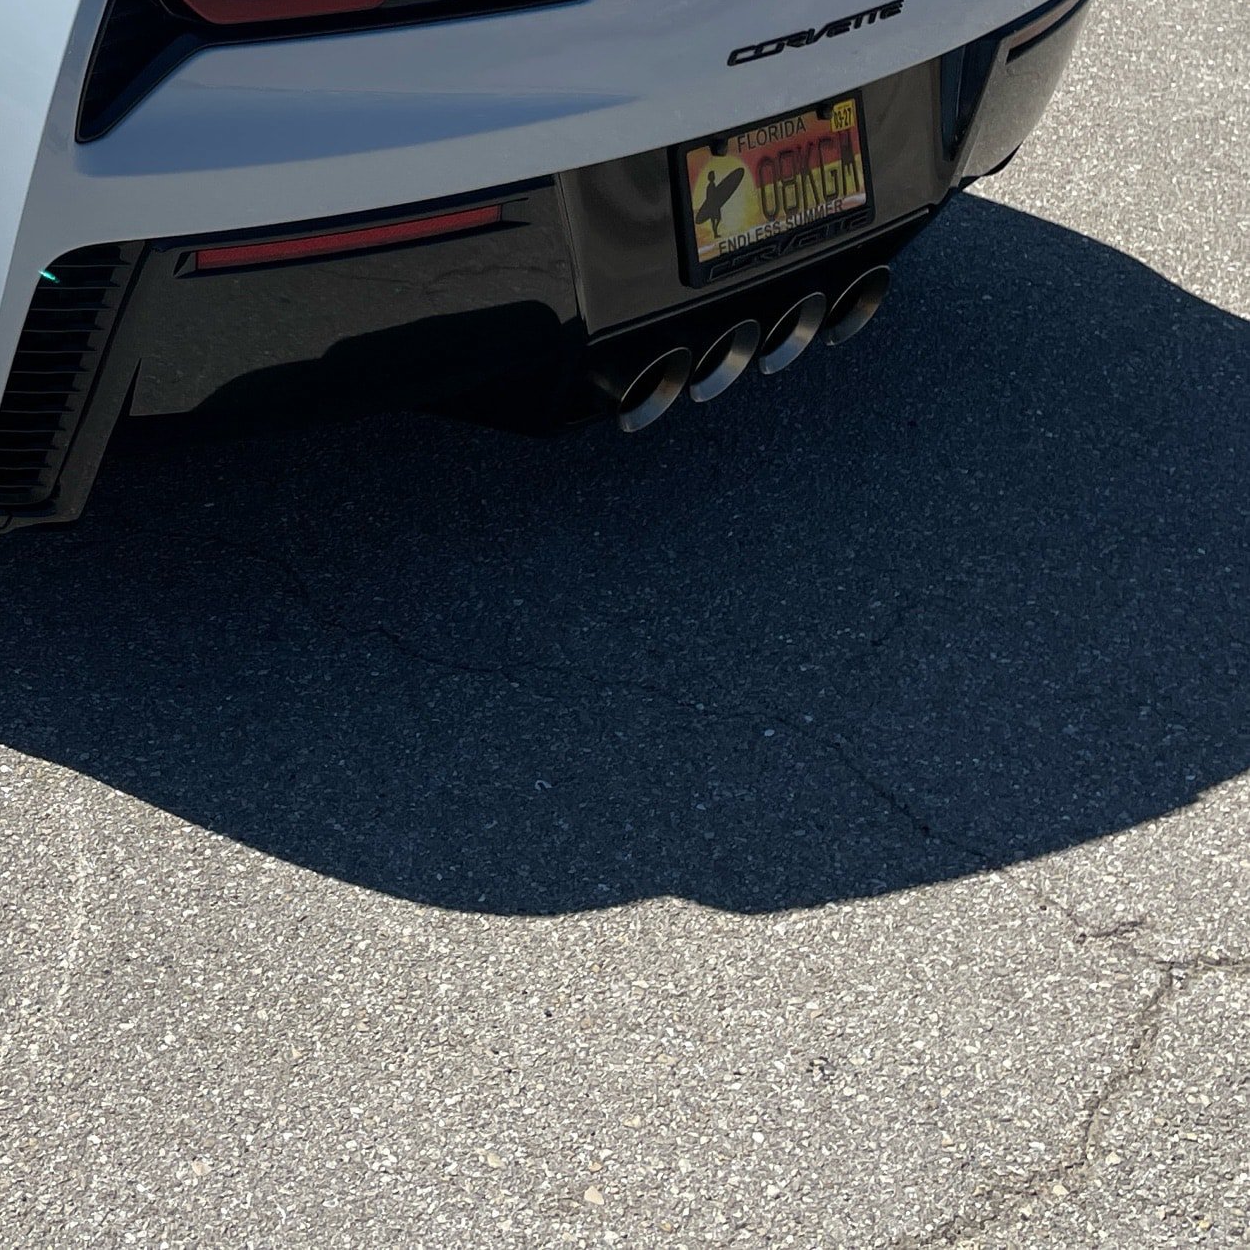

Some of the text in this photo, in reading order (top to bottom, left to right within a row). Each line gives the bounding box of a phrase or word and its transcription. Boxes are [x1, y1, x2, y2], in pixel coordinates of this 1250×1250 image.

[737, 116, 807, 153] FLORIDA
[718, 200, 844, 257] ENDLESS SUMMER
